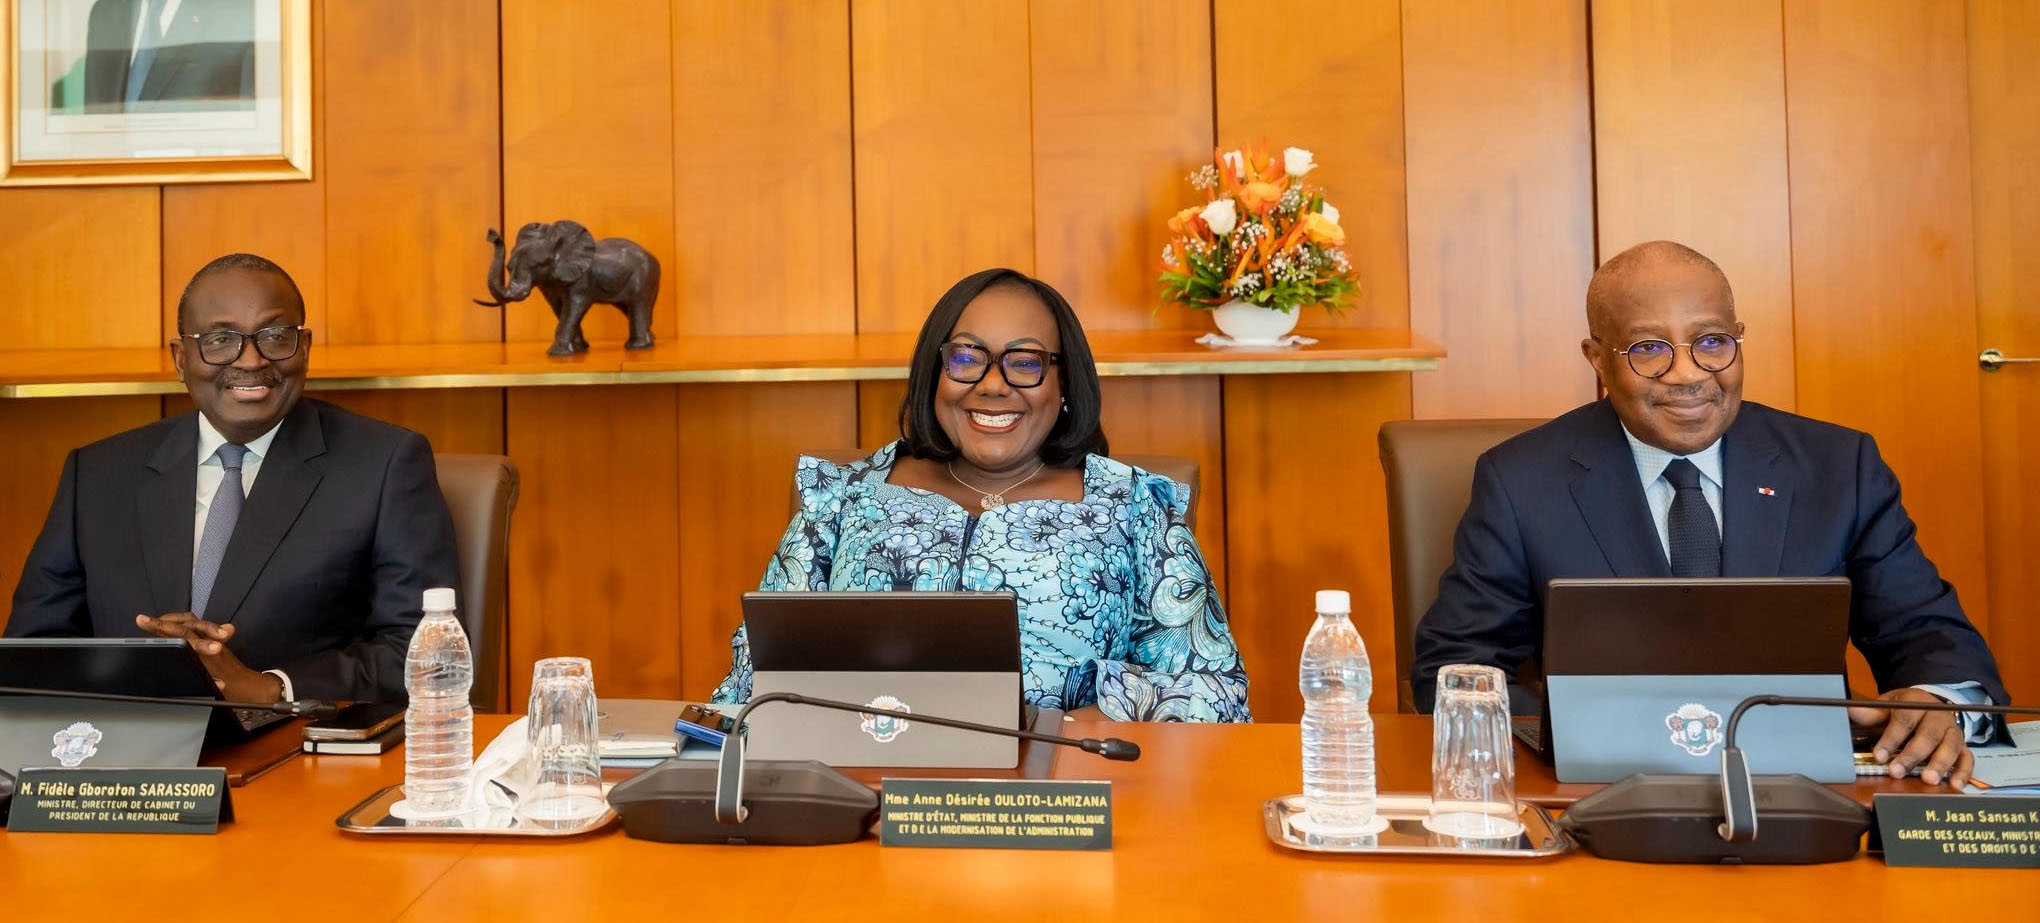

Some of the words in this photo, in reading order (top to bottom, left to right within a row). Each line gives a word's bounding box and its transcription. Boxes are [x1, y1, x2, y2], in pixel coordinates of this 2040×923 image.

[21, 782, 33, 796] M.
[38, 782, 74, 796] Fidèle
[79, 783, 136, 797] Gboroton
[139, 783, 216, 797] SARASSORO
[37, 800, 79, 809] MINISTRE,
[82, 801, 128, 809] DIRECTEUR
[131, 801, 141, 809] DE
[144, 801, 180, 810] CABINET
[183, 801, 196, 810] DU
[885, 793, 909, 804] Mme
[913, 794, 942, 805] Anne
[946, 793, 991, 806] Désirée
[994, 794, 1108, 807] OULOTO-LAMIZANA
[49, 811, 96, 820] PRESIDENT
[99, 812, 109, 820] DE
[112, 812, 124, 820] LA
[127, 812, 180, 821] REPUBLIQUE
[888, 812, 924, 821] MINISTRE
[926, 810, 958, 823] D'ÉTAT,
[960, 813, 996, 823] MINISTRE
[999, 814, 1009, 823] DE
[1011, 814, 1022, 823] LA
[1024, 814, 1064, 824] FONCTION
[1065, 814, 1105, 824] PUBLIQUE
[1925, 810, 1940, 822] M.
[1945, 810, 1974, 823] Jean
[1977, 810, 2026, 823] Sansan
[899, 825, 909, 833] ET
[927, 826, 938, 834] LA
[940, 826, 1004, 835] MODERNISATION
[1006, 827, 1017, 836] DE
[1018, 827, 1094, 837] L'ADMINISTRATION
[1898, 829, 1931, 840] GARDE
[1934, 830, 1953, 840] DES
[1956, 830, 1999, 841] SCEAUX,
[1943, 843, 1955, 853] ET
[1958, 844, 1977, 854] DES
[1981, 844, 2017, 854] DROITS
